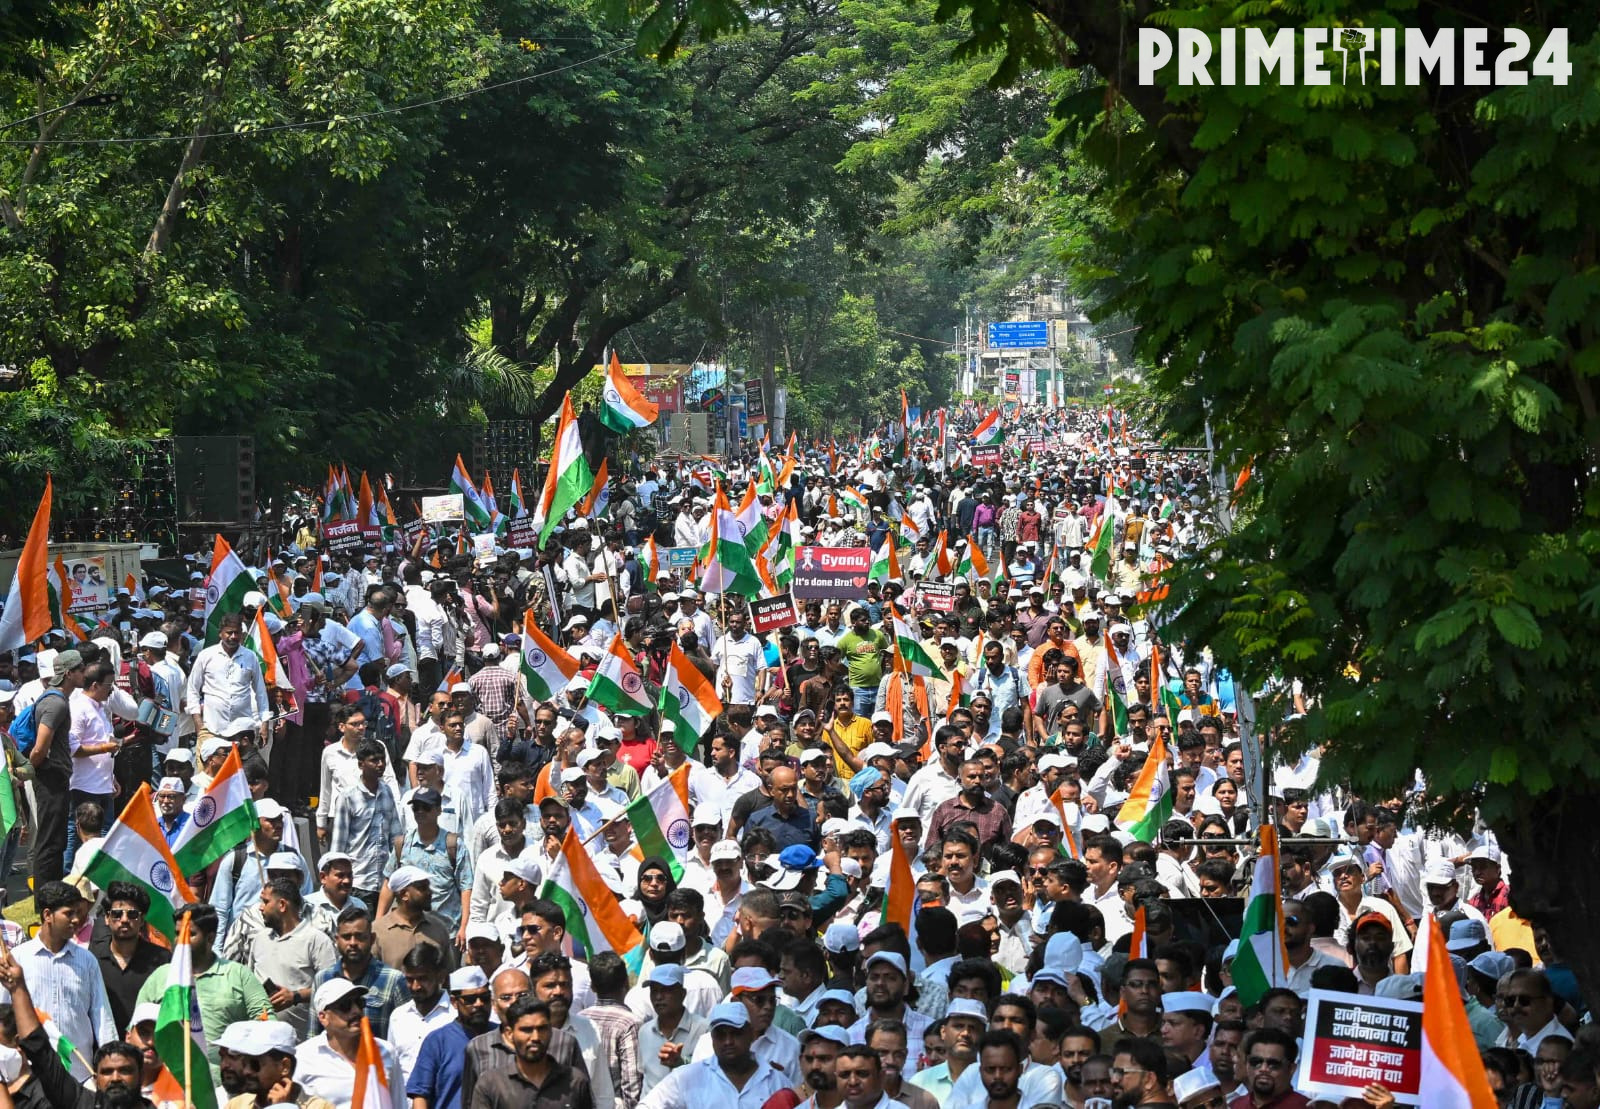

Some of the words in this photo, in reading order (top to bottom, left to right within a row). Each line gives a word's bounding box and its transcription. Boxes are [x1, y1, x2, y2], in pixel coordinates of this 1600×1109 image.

[821, 553, 867, 568] Gyanu,
[795, 577, 809, 586] It's
[811, 577, 833, 587] done
[834, 577, 852, 587] Bro!
[758, 606, 770, 614] Our
[771, 602, 787, 612] Vote
[759, 615, 771, 624] Our
[771, 610, 791, 623] Right!
[1334, 1007, 1392, 1027] राजीनामा
[1332, 1023, 1389, 1042] राजीनामा
[1329, 1044, 1368, 1061] ज्ञानेश
[1369, 1052, 1404, 1068] कुमार
[1325, 1061, 1382, 1082] राजीनामा
